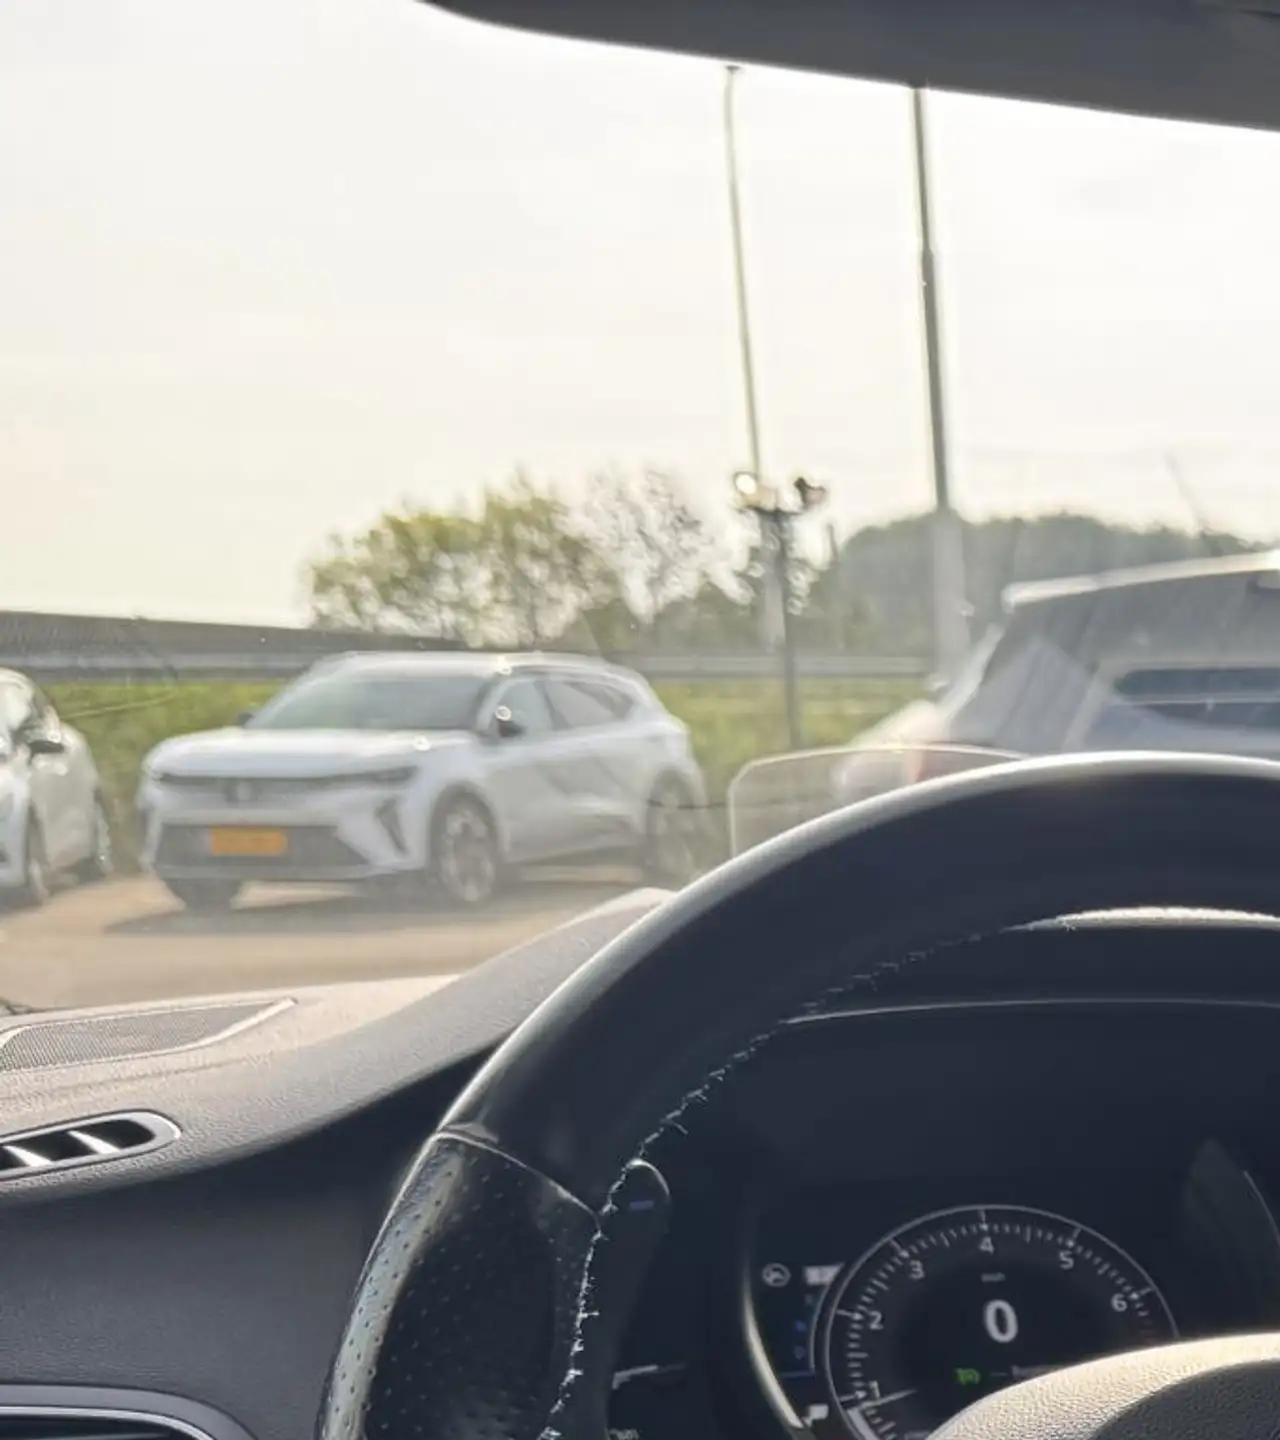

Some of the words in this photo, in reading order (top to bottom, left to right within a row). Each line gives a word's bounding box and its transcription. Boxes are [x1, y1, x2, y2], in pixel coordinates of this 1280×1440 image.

[980, 1236, 995, 1254] 4
[909, 1260, 925, 1280] 3
[1059, 1251, 1075, 1270] 5
[1111, 1293, 1128, 1312] 6
[868, 1310, 884, 1330] 2
